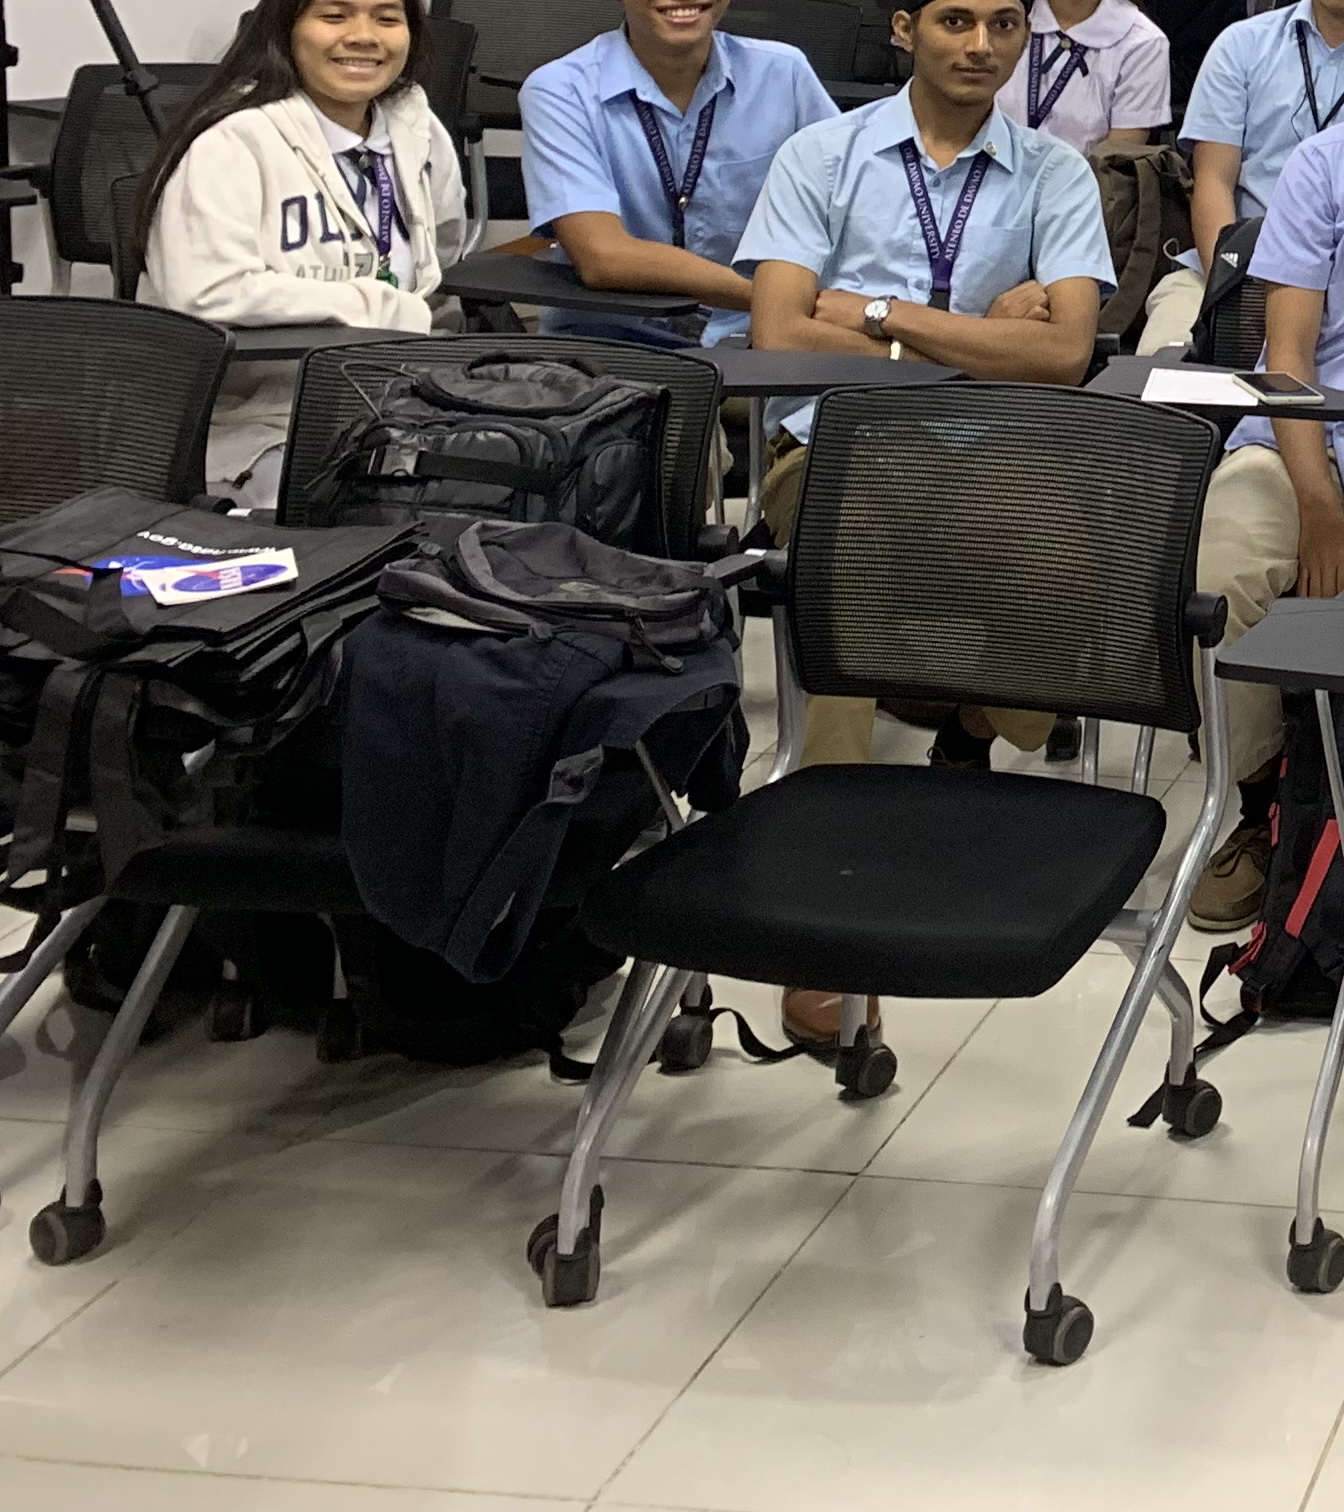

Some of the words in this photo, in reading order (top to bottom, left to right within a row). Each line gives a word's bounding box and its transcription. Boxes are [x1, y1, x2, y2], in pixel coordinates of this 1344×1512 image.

[962, 168, 983, 203] DAVAO
[906, 161, 924, 197] DAVAO
[915, 197, 942, 260] UNIVERSITY
[957, 204, 969, 218] DE
[941, 218, 965, 261] ATENEO
